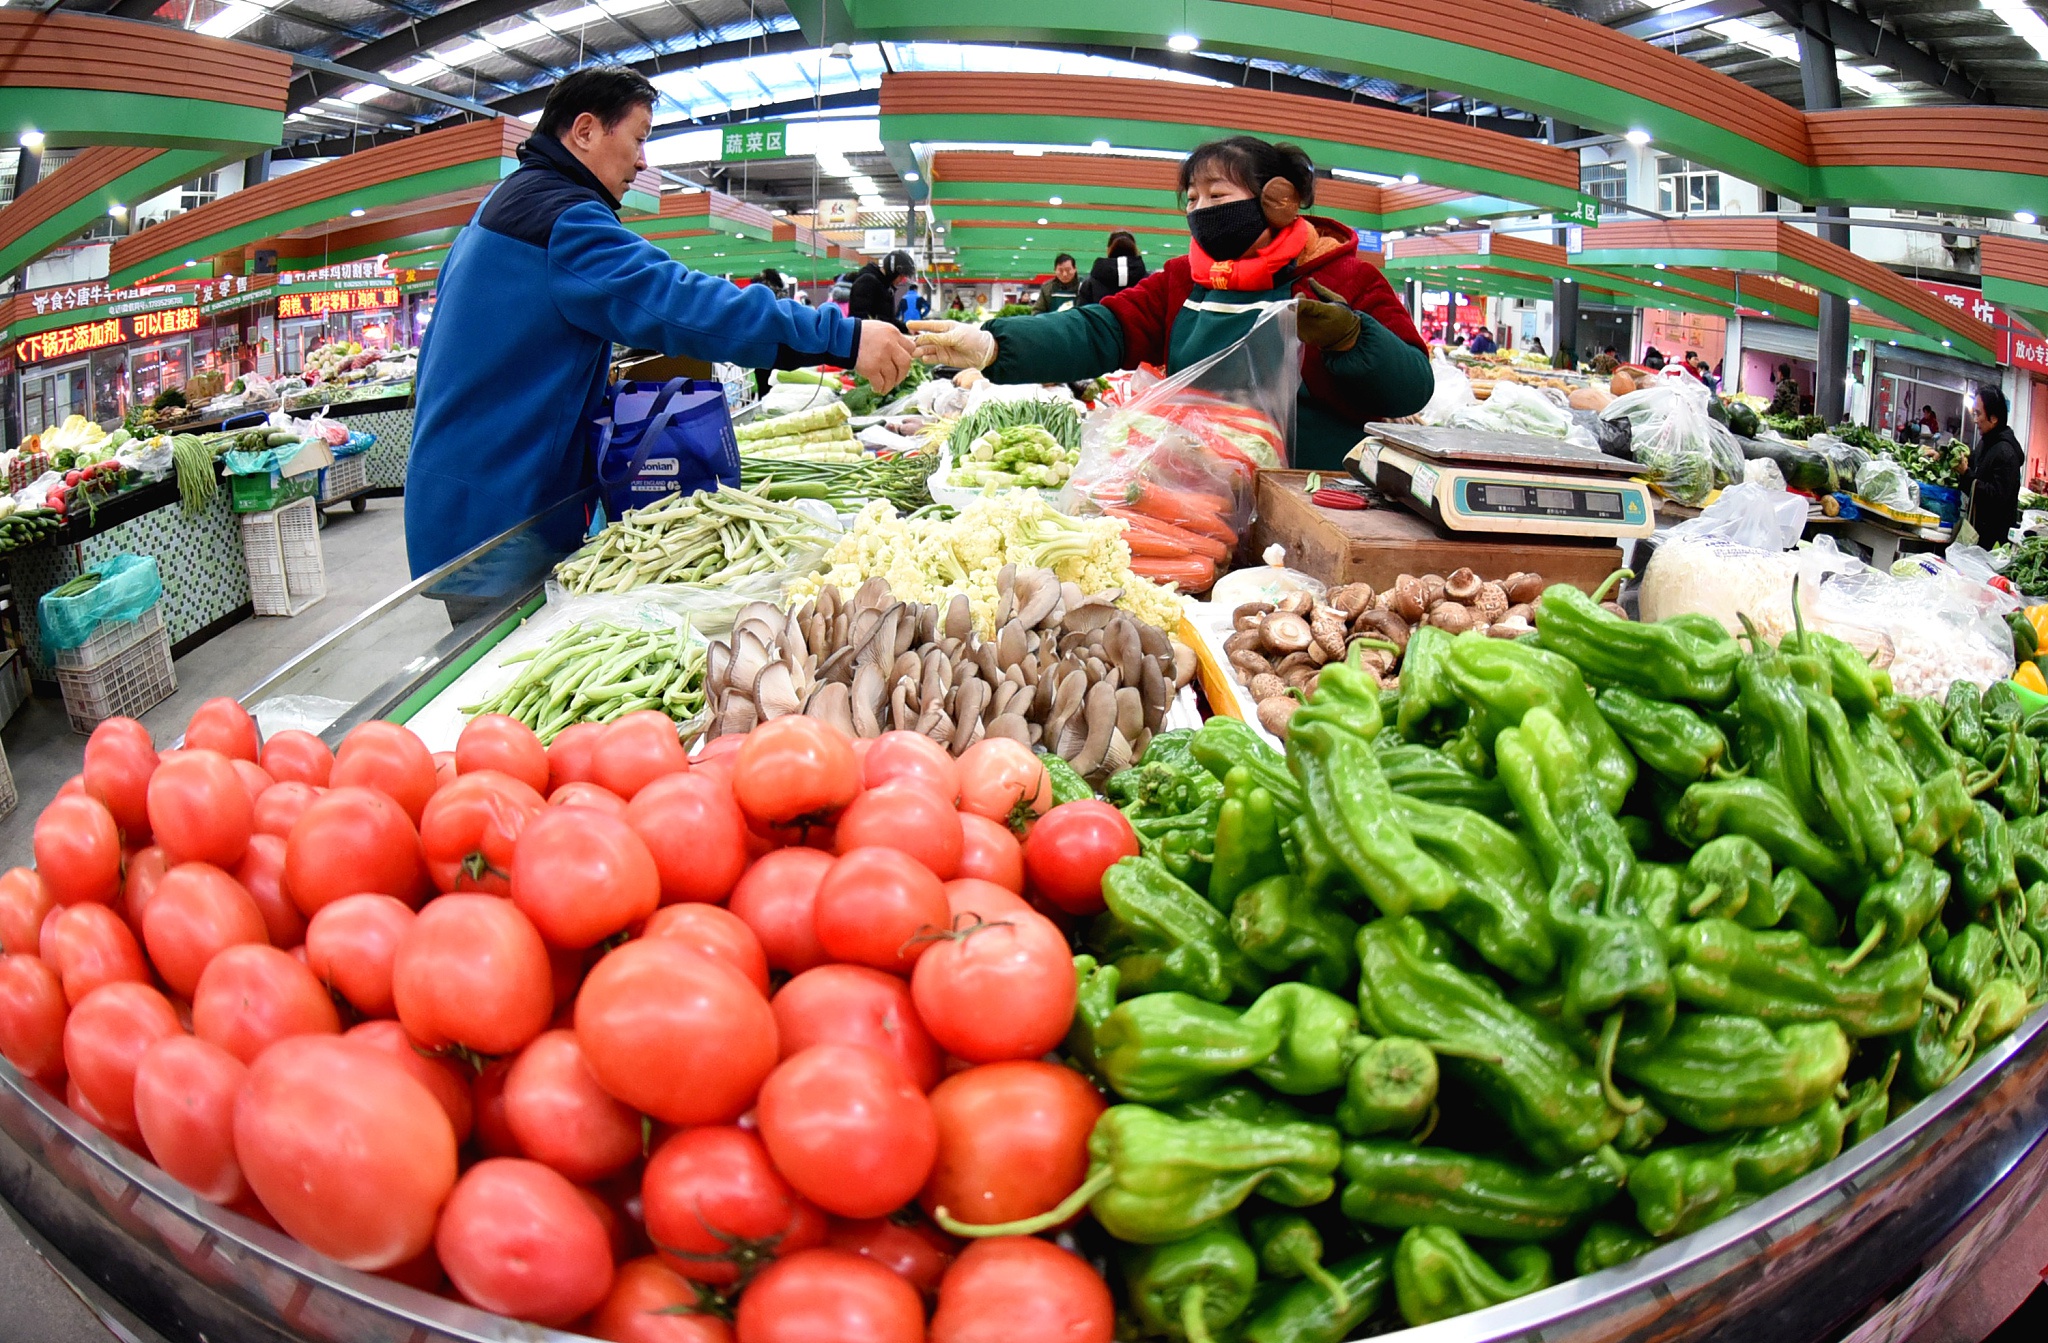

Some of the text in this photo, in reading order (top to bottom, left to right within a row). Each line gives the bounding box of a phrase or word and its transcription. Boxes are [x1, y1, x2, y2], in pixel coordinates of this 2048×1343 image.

[725, 131, 782, 154] 蔬菜区
[1563, 201, 1596, 222] 菜区
